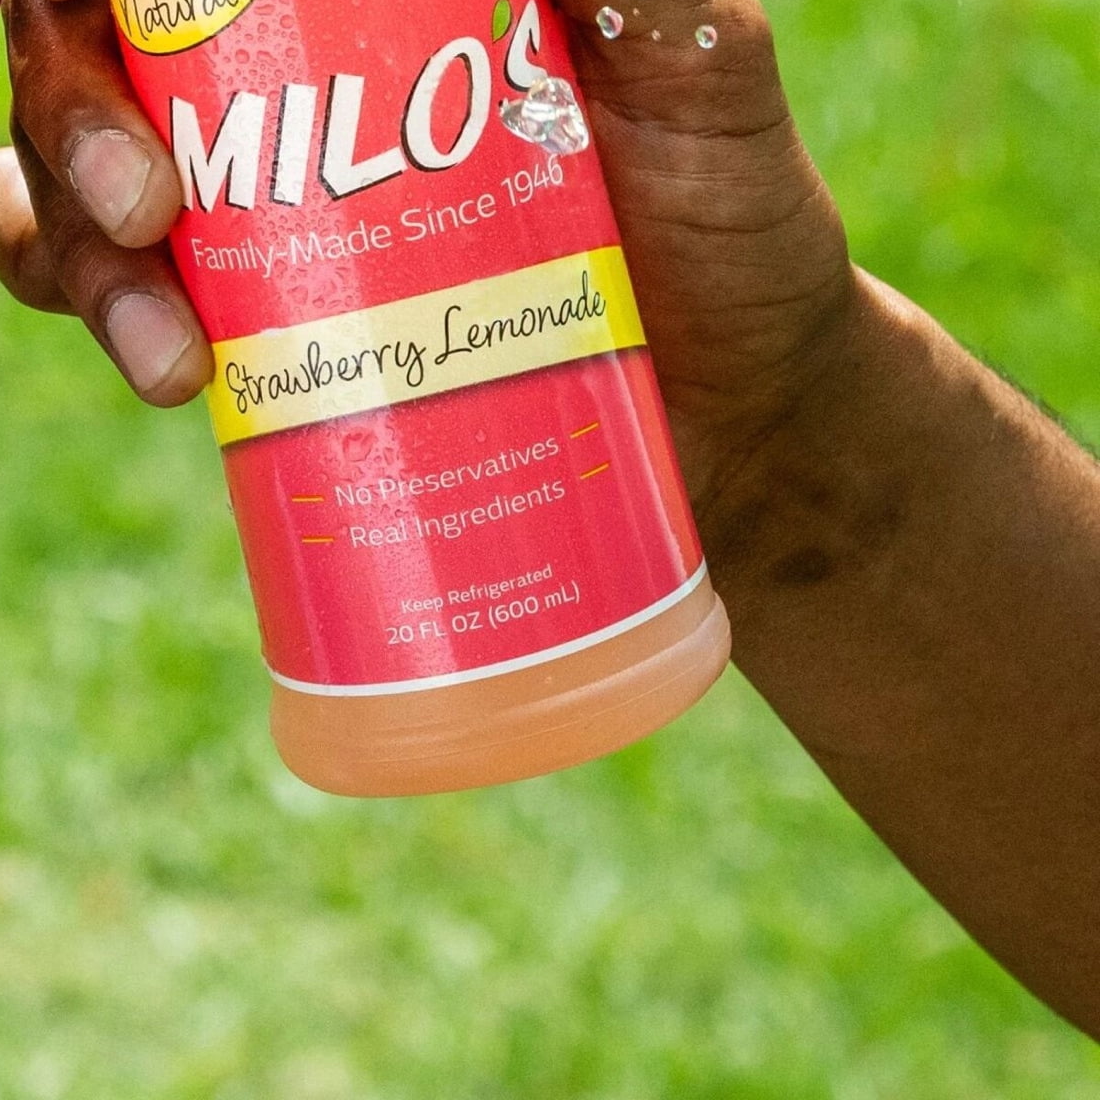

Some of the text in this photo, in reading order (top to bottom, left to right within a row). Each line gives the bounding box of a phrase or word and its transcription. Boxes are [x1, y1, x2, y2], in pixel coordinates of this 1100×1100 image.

[190, 152, 564, 280] Family-Made Since 1946
[225, 269, 607, 415] Strawberry Lemonade
[333, 433, 561, 509] No Preservatives
[349, 478, 567, 549] Real Ingredients
[385, 579, 581, 646] 20 FL OZ (600 mL)
[401, 563, 554, 615] Keep Refrigerated
